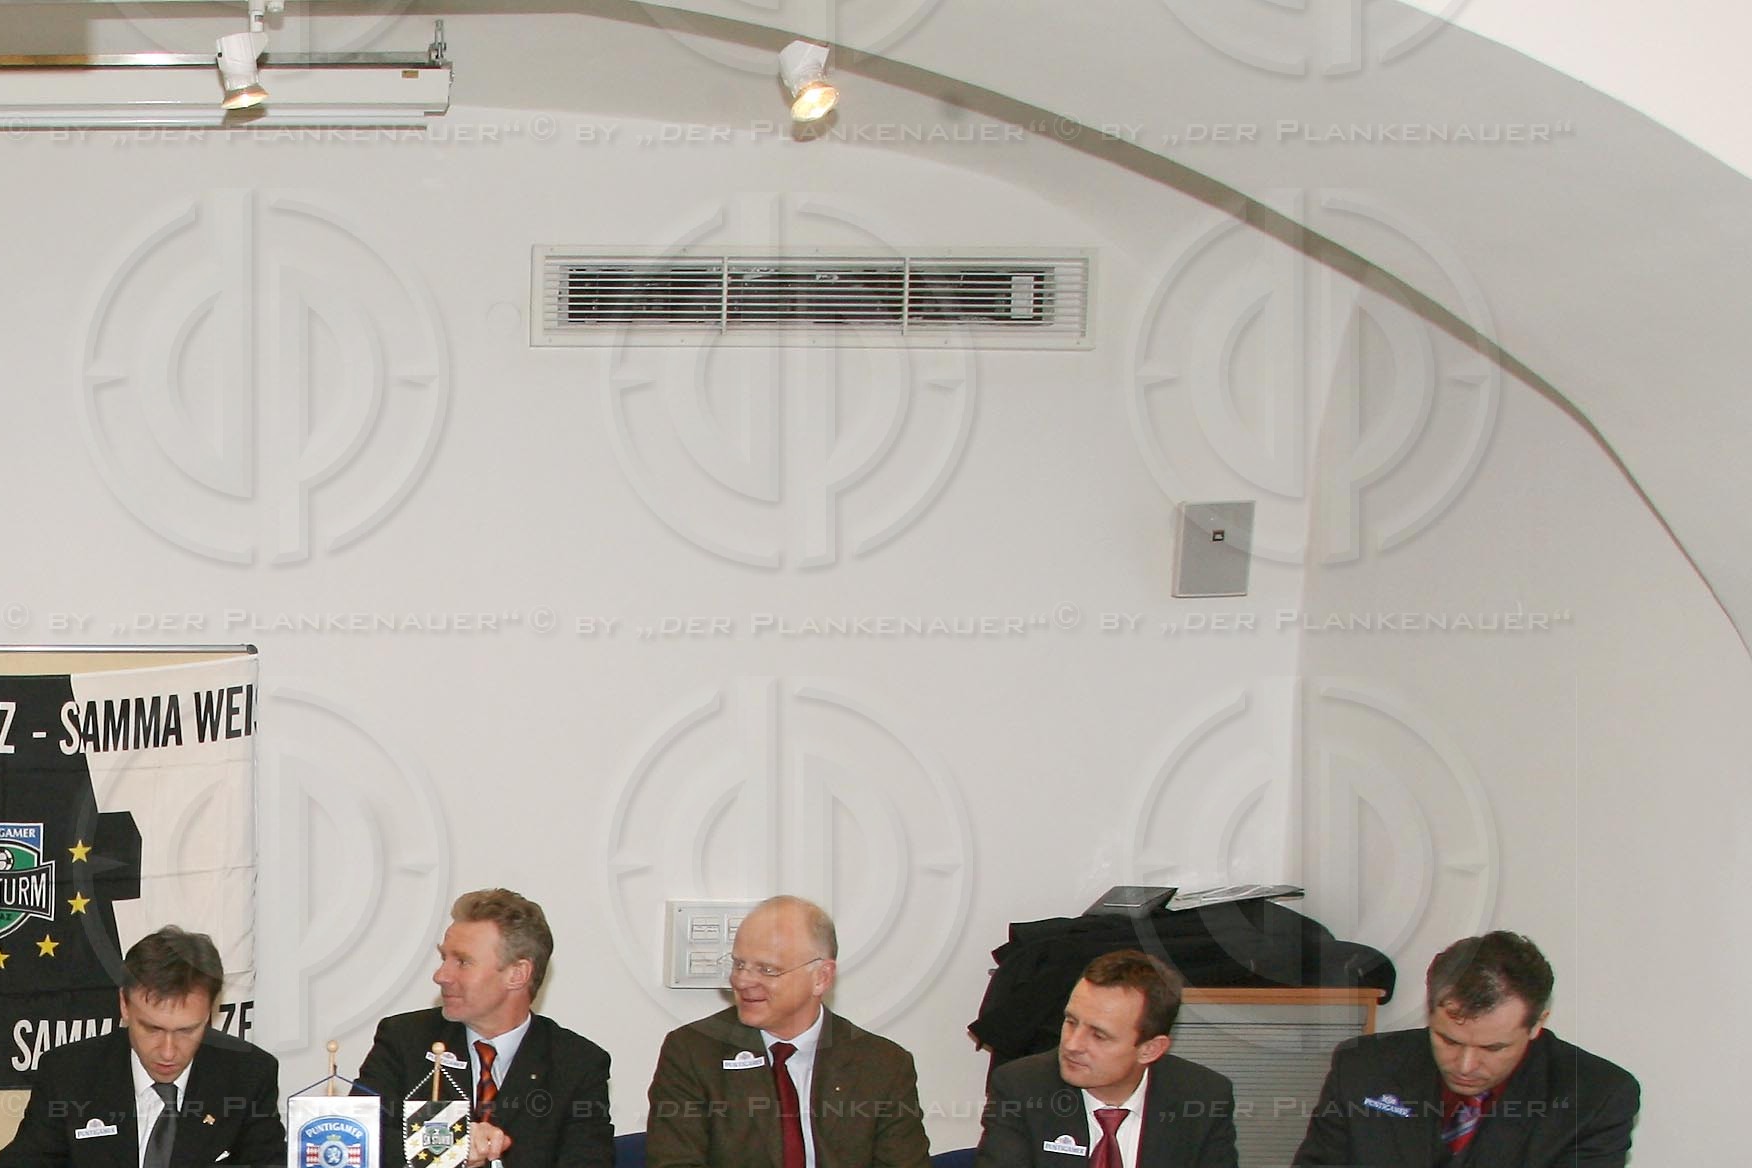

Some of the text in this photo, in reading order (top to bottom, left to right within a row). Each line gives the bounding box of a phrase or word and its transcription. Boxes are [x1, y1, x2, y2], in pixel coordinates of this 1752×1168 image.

[59, 700, 183, 756] SAMMA
[194, 684, 257, 744] WEI
[305, 1122, 363, 1139] PUNTIGAMER
